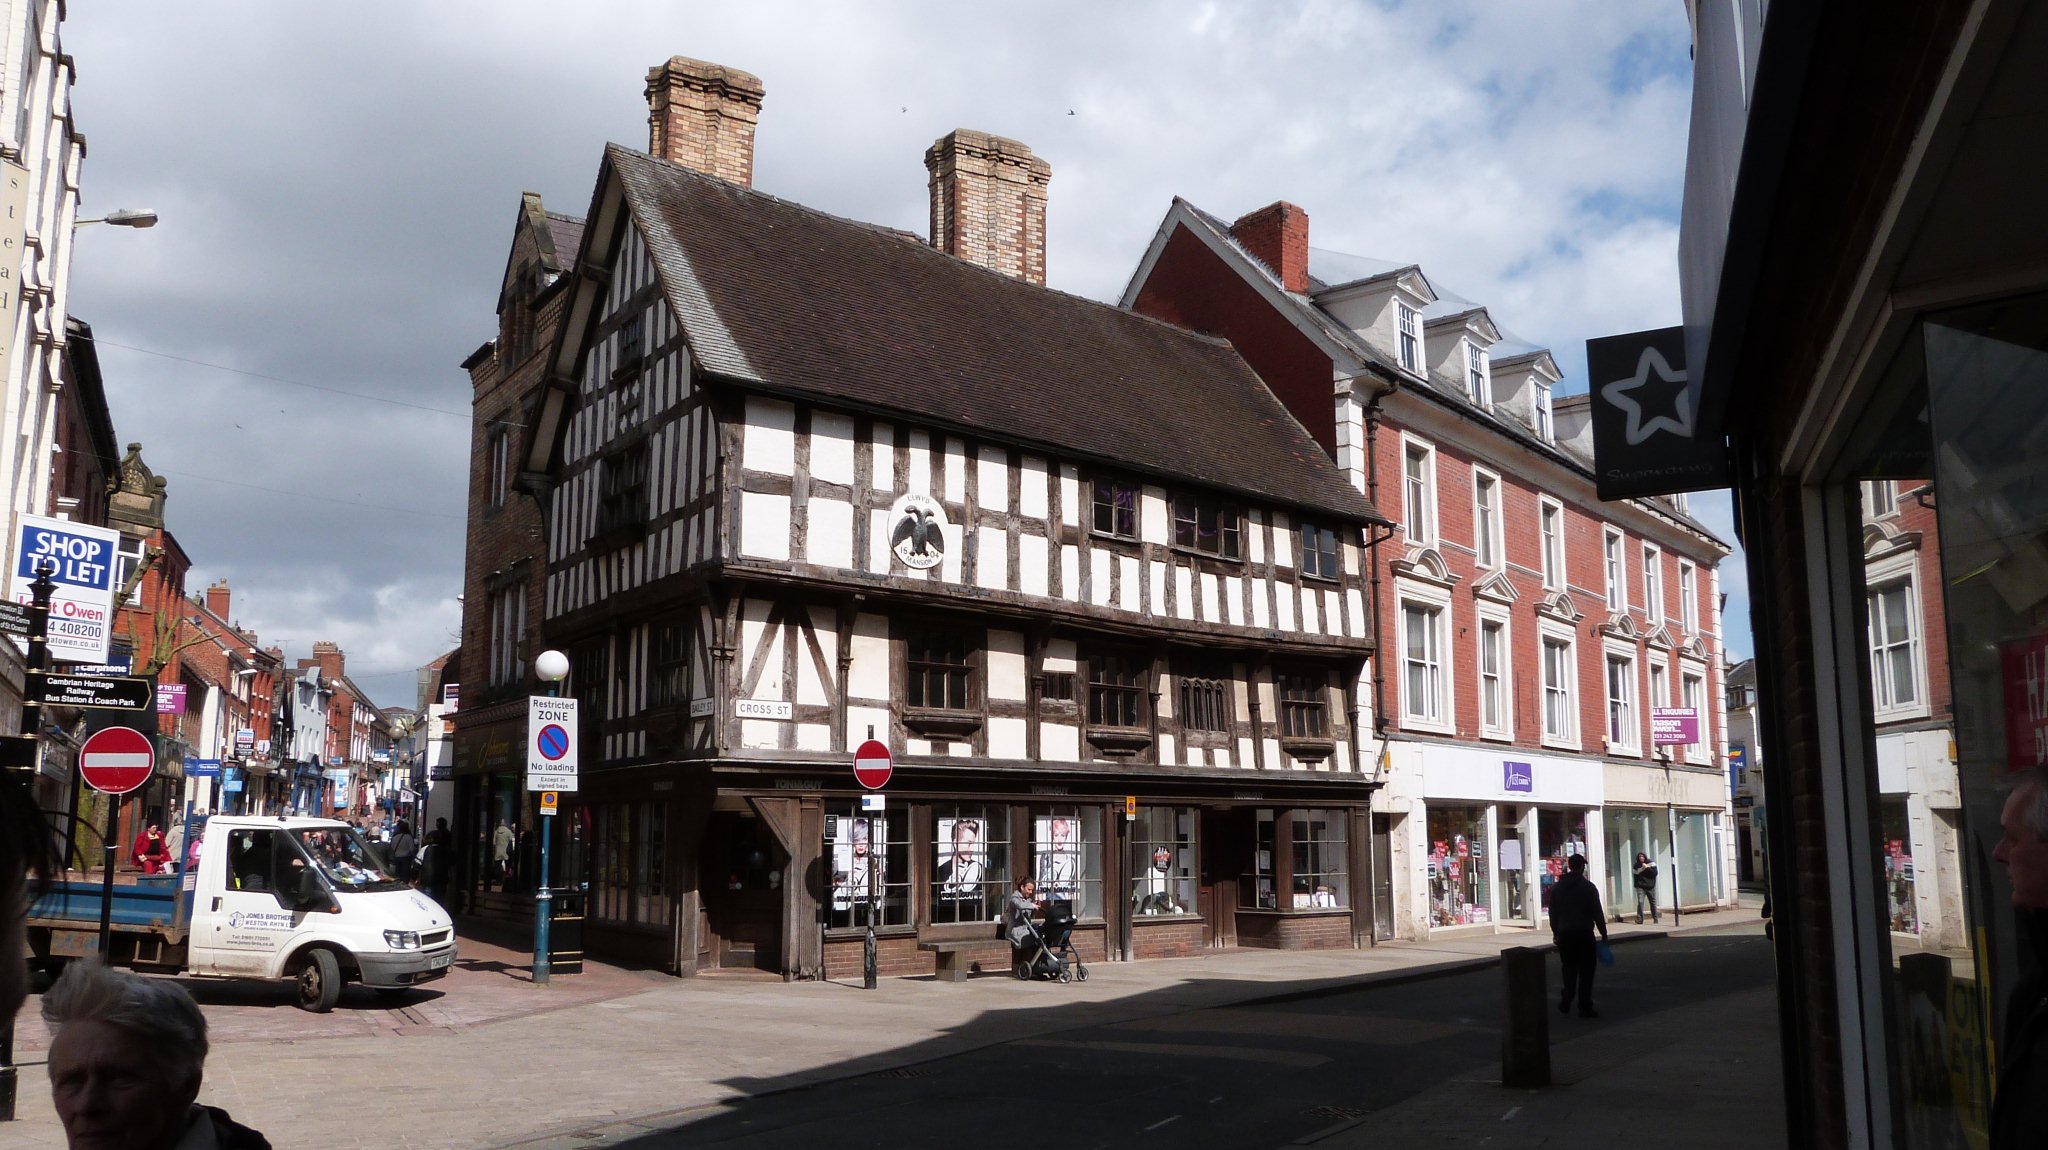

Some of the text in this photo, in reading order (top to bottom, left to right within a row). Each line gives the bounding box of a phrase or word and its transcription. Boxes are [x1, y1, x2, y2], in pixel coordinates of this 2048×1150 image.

[36, 532, 101, 562] SHOP
[27, 552, 105, 585] TO LET
[63, 601, 103, 621] Owen
[60, 622, 101, 638] 408200
[47, 636, 100, 649] atowen.co.uk
[47, 678, 114, 689] Cambrian Heritage
[66, 687, 95, 697] Railway
[45, 694, 60, 702] Bus
[95, 697, 118, 706] Coach
[533, 699, 574, 709] Restricted
[740, 703, 772, 714] CROSS
[538, 711, 569, 721] ZONE
[531, 762, 575, 773] No loading
[540, 776, 559, 784] Except
[246, 912, 296, 922] JONES BROTHERS
